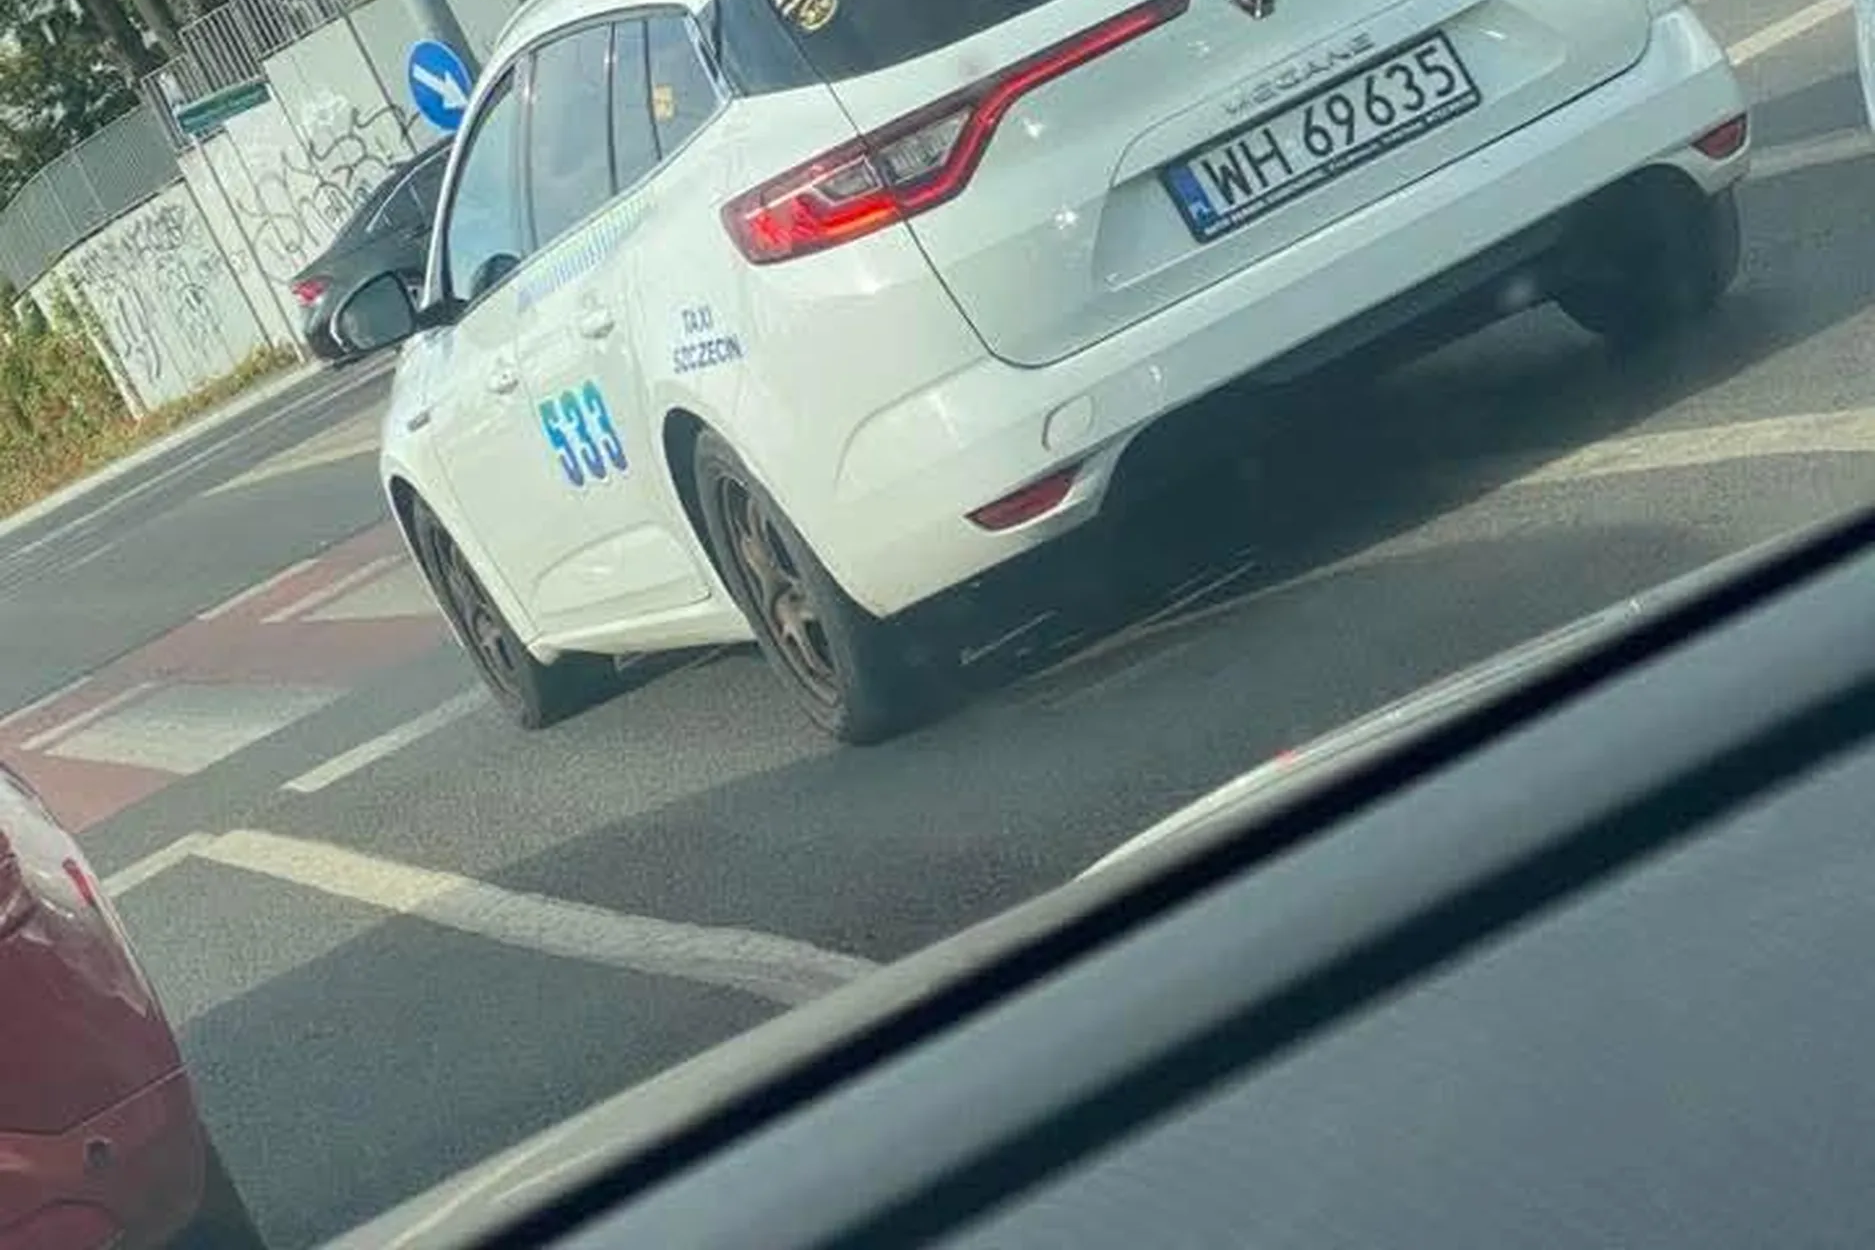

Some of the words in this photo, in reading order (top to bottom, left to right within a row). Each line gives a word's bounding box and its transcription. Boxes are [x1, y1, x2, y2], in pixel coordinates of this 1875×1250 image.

[1202, 127, 1294, 206] WH
[1302, 43, 1457, 158] 69635
[681, 304, 714, 336] TAXI
[537, 378, 629, 488] 533
